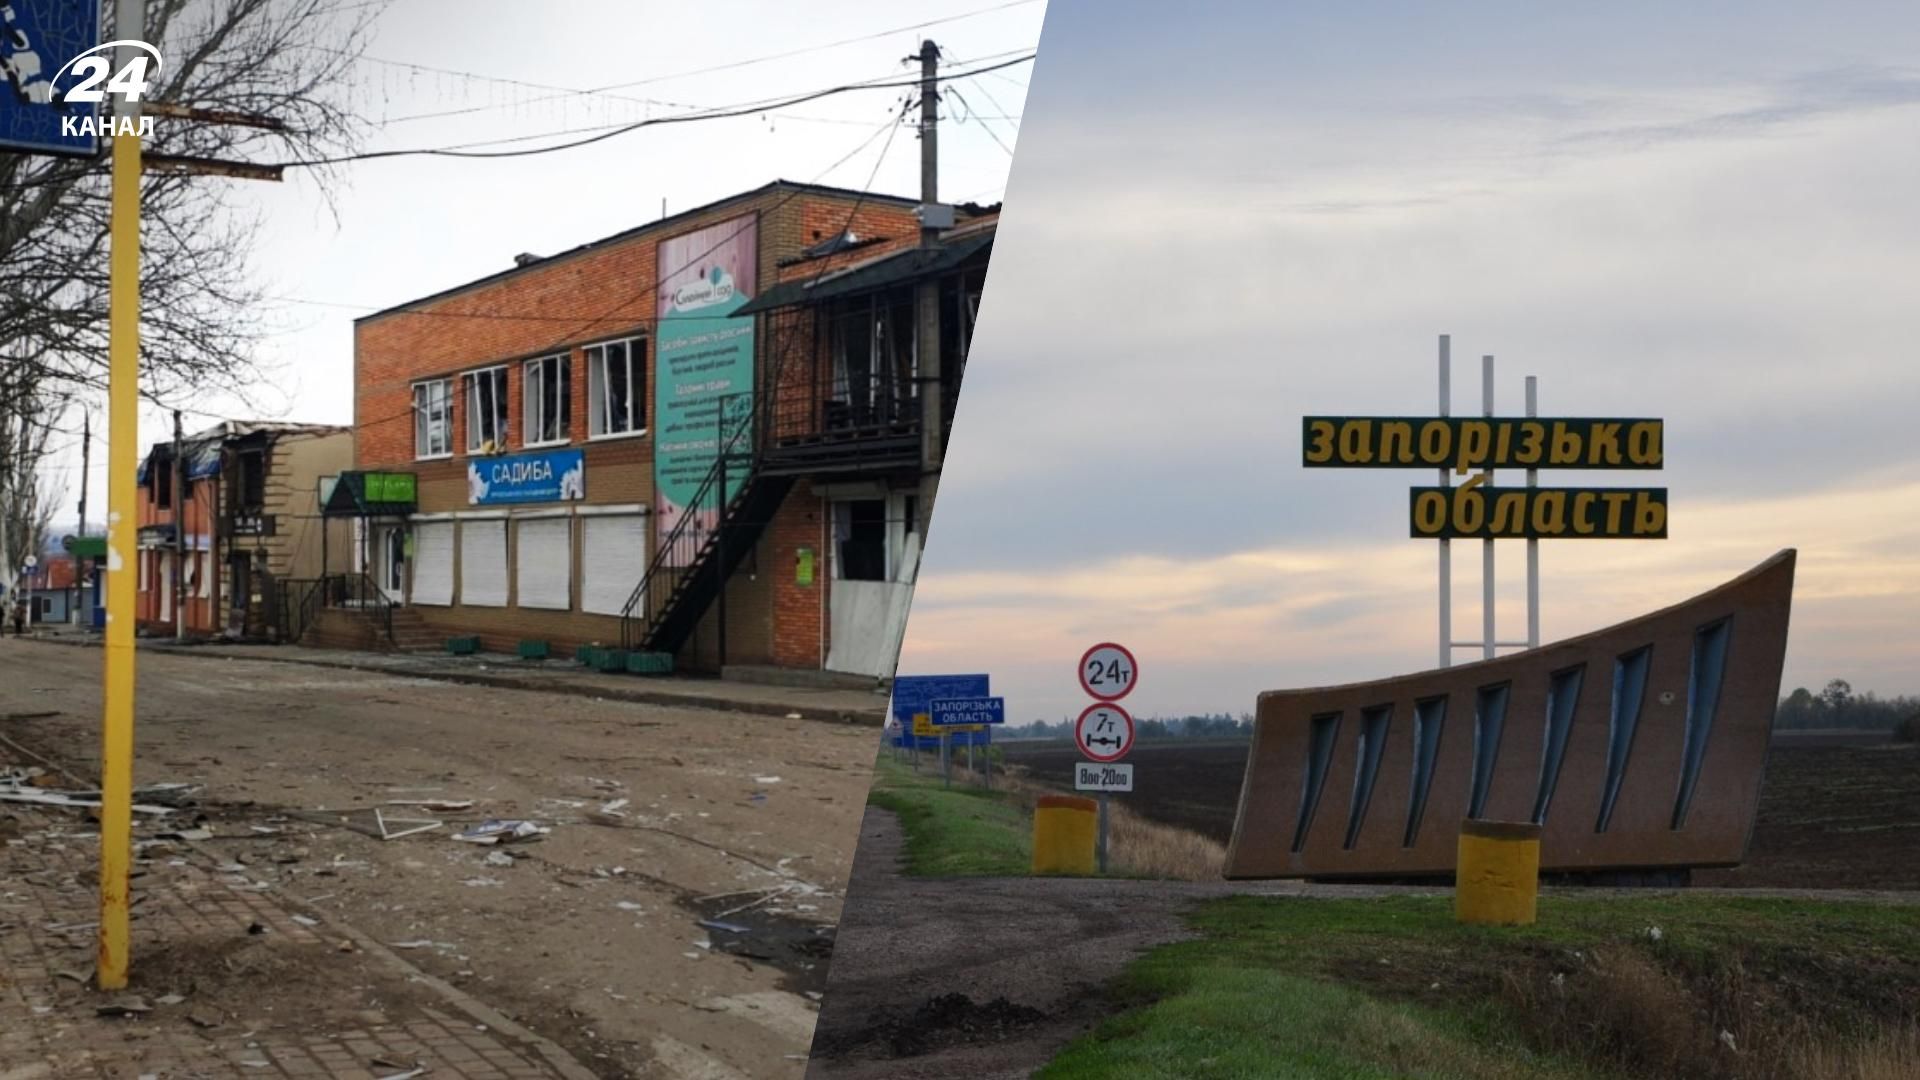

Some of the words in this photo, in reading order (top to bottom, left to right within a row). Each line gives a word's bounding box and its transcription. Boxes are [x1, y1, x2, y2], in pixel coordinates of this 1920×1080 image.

[491, 460, 553, 486] САДИБА
[933, 701, 1001, 713] ЗАПОРІЗЬКА
[942, 712, 993, 723] ОБЛАСТЬ
